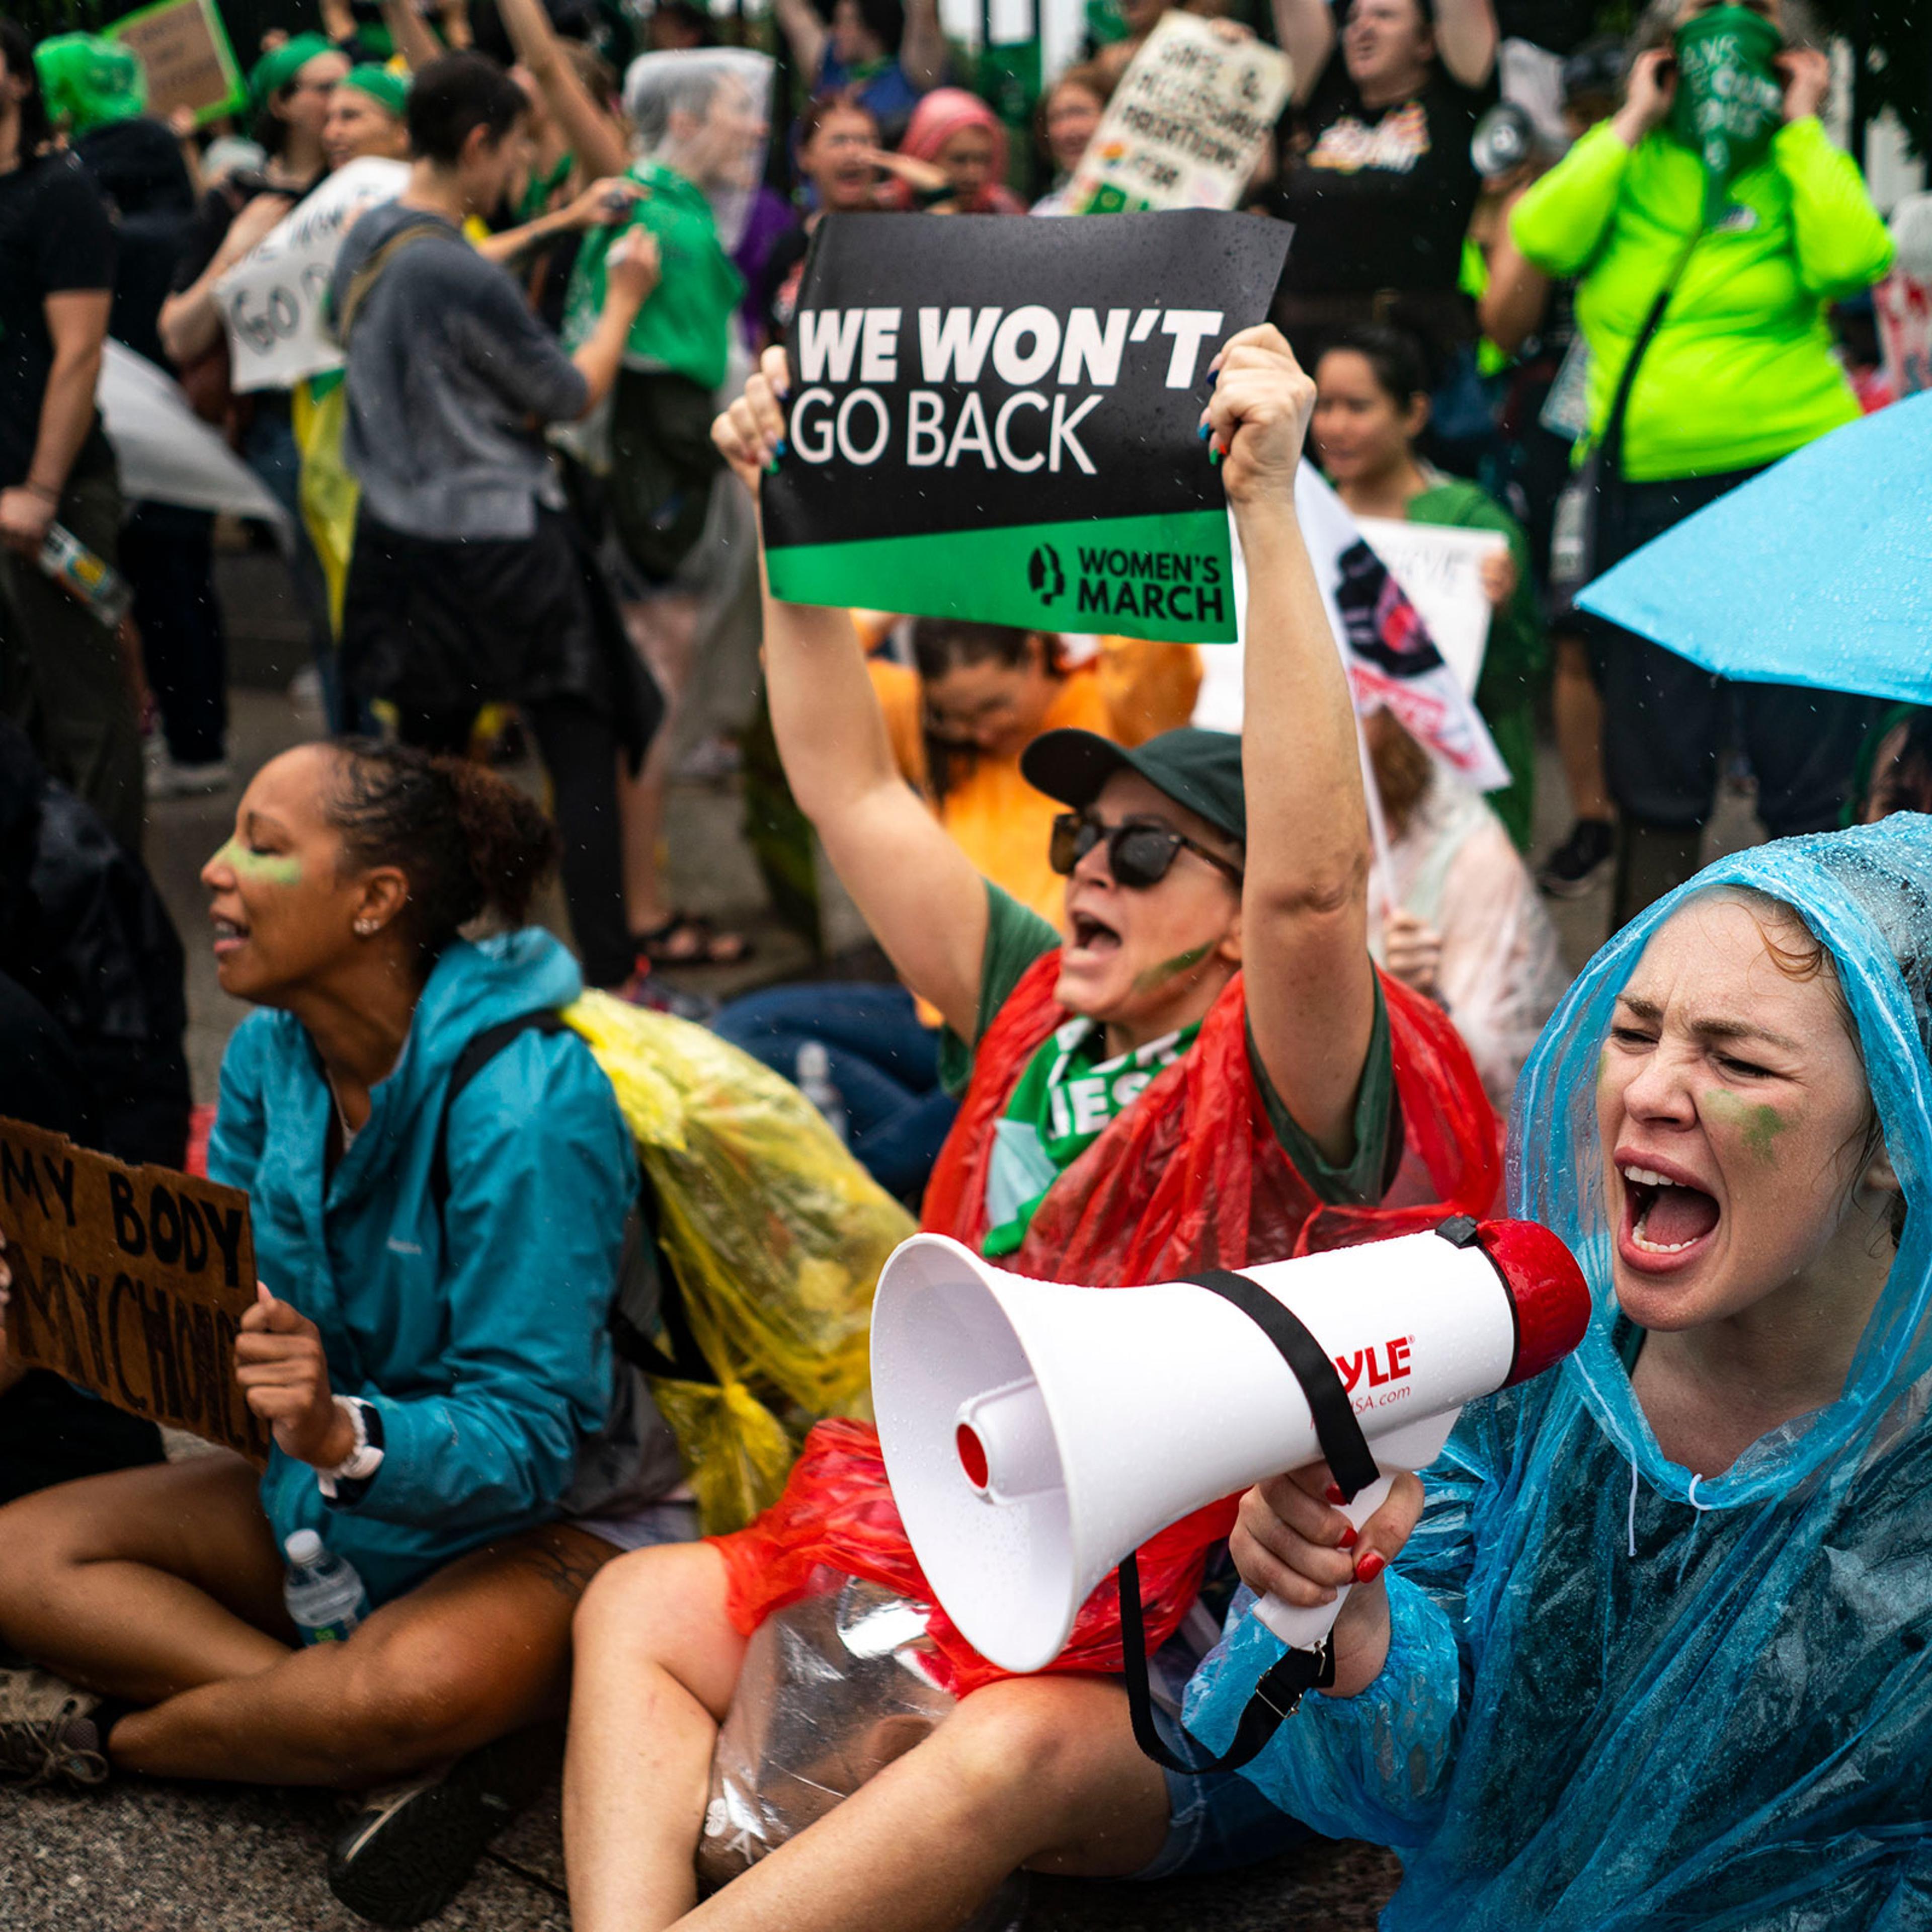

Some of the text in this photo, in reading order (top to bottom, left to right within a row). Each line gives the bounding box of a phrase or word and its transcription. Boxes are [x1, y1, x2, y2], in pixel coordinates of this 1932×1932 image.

[799, 304, 1224, 389] WE WON'T
[790, 387, 1104, 475] GO BACK
[1078, 547, 1221, 584] WOMEN'S
[1078, 578, 1224, 623] MARCH
[2, 1140, 245, 1288] MY BODY
[6, 1241, 110, 1395] MY
